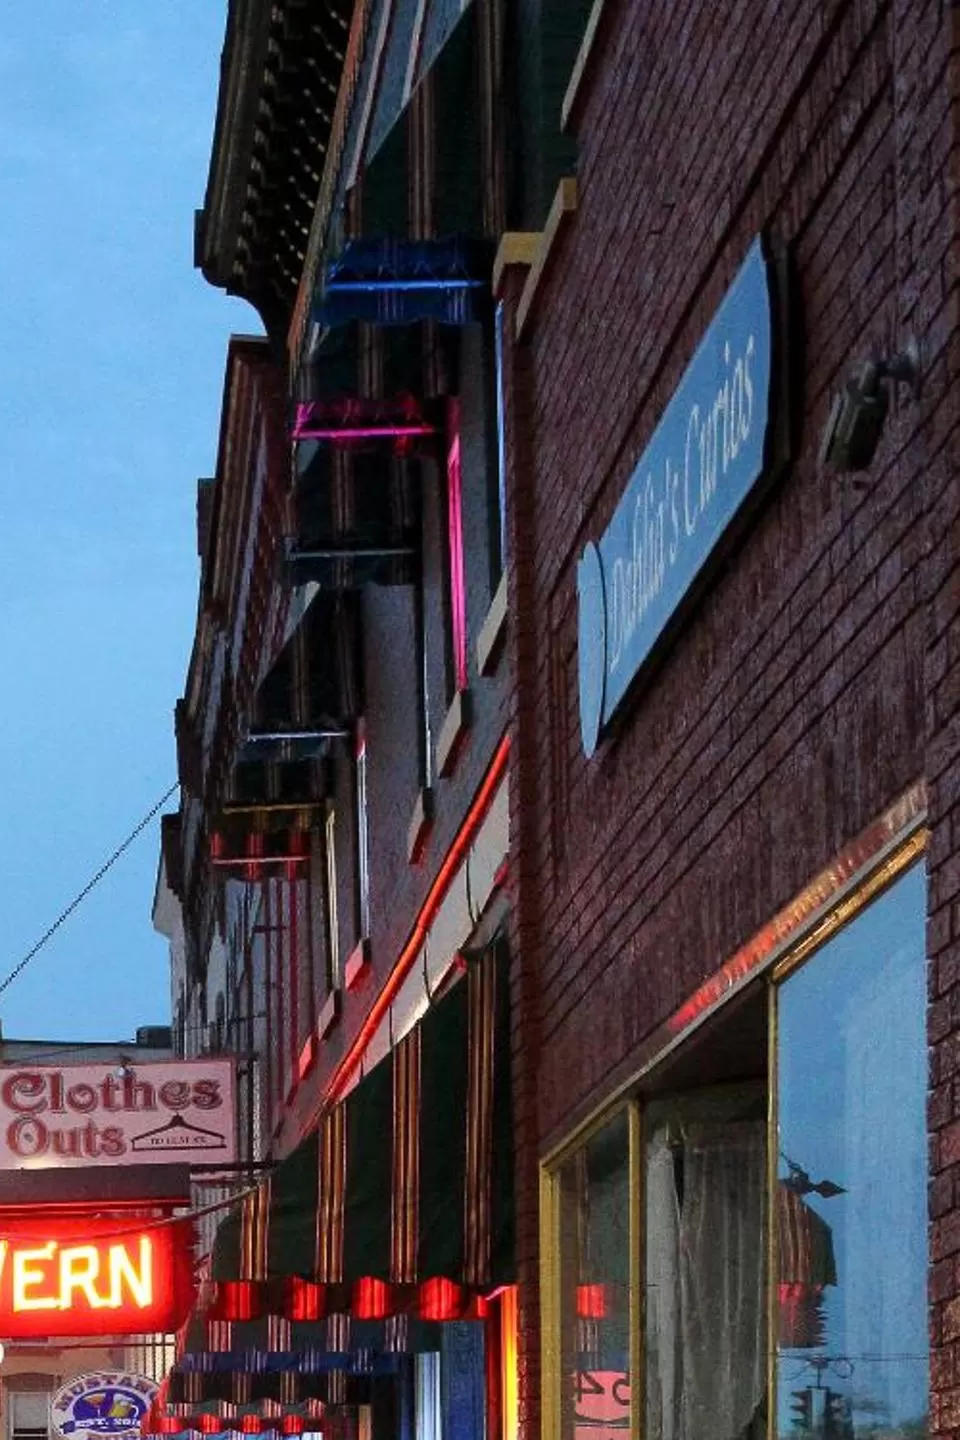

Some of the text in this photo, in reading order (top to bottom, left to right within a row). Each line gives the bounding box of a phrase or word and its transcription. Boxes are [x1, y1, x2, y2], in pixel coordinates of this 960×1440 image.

[1, 1069, 224, 1115] Clothes
[6, 1114, 128, 1158] Outs
[54, 1375, 158, 1411] MUSTAN
